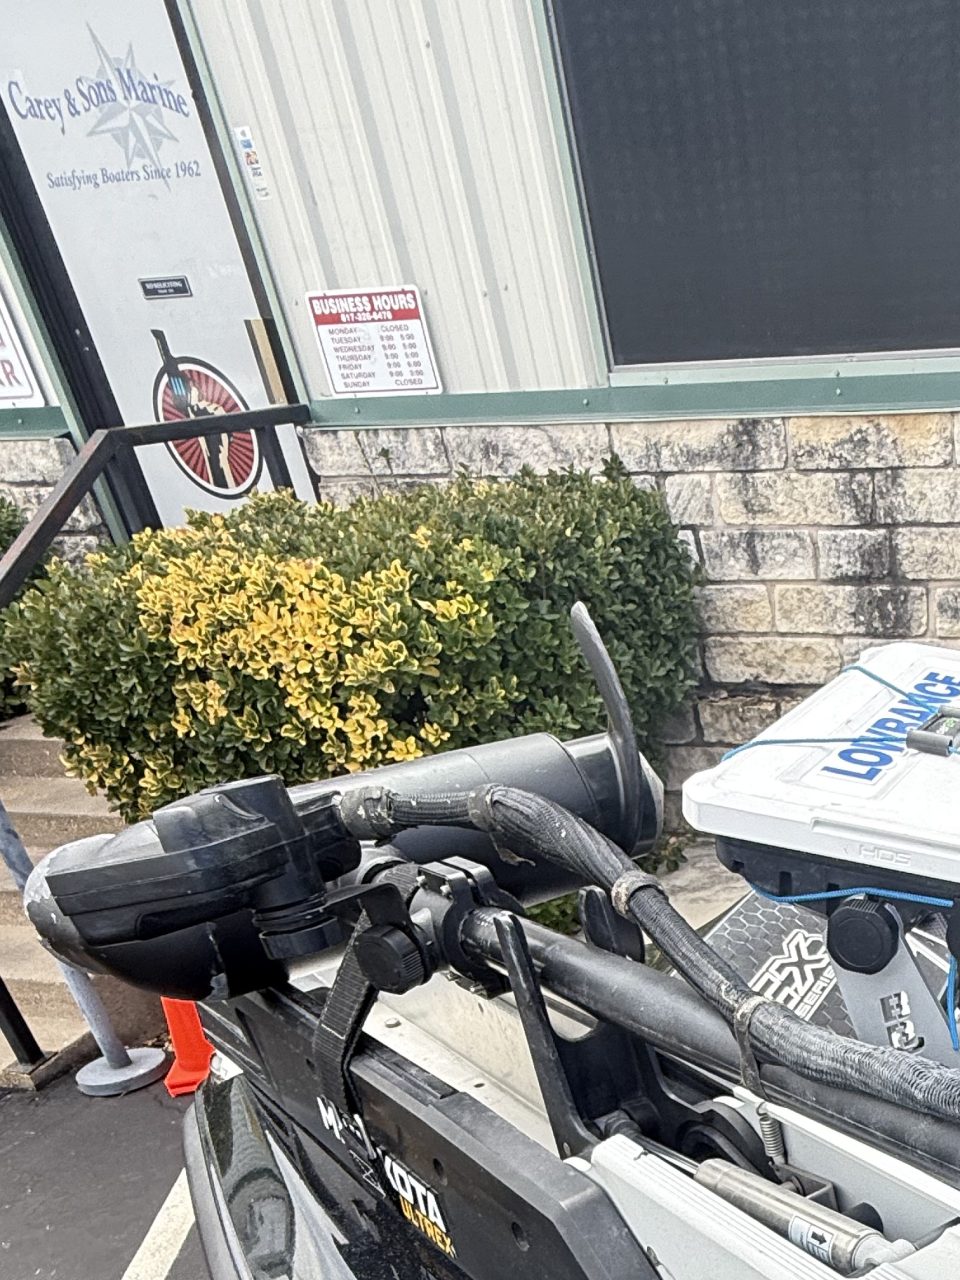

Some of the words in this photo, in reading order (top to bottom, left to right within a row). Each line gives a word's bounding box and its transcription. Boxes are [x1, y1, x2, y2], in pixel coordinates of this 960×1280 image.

[8, 80, 65, 136] Carey
[64, 88, 80, 118] &
[76, 77, 118, 113] Sons
[115, 67, 190, 118] Marine
[47, 169, 100, 191] Satisfying
[100, 167, 141, 184] Boaters
[143, 164, 171, 181] Since
[174, 159, 202, 179] 1962
[311, 295, 372, 315] BUSINESS
[371, 292, 416, 312] HOURS
[328, 327, 358, 335] MONDAY
[380, 324, 409, 332] CLOSED
[330, 336, 361, 344] TUESDAY
[333, 344, 375, 353] WEDNESDAY
[336, 354, 372, 362] THURSDAY
[338, 363, 362, 371] FRIDAY
[341, 371, 376, 380] SATURDAY
[343, 380, 370, 389] SUNDAY
[394, 378, 423, 386] CLOSED
[400, 1195, 454, 1256] ULTREX
